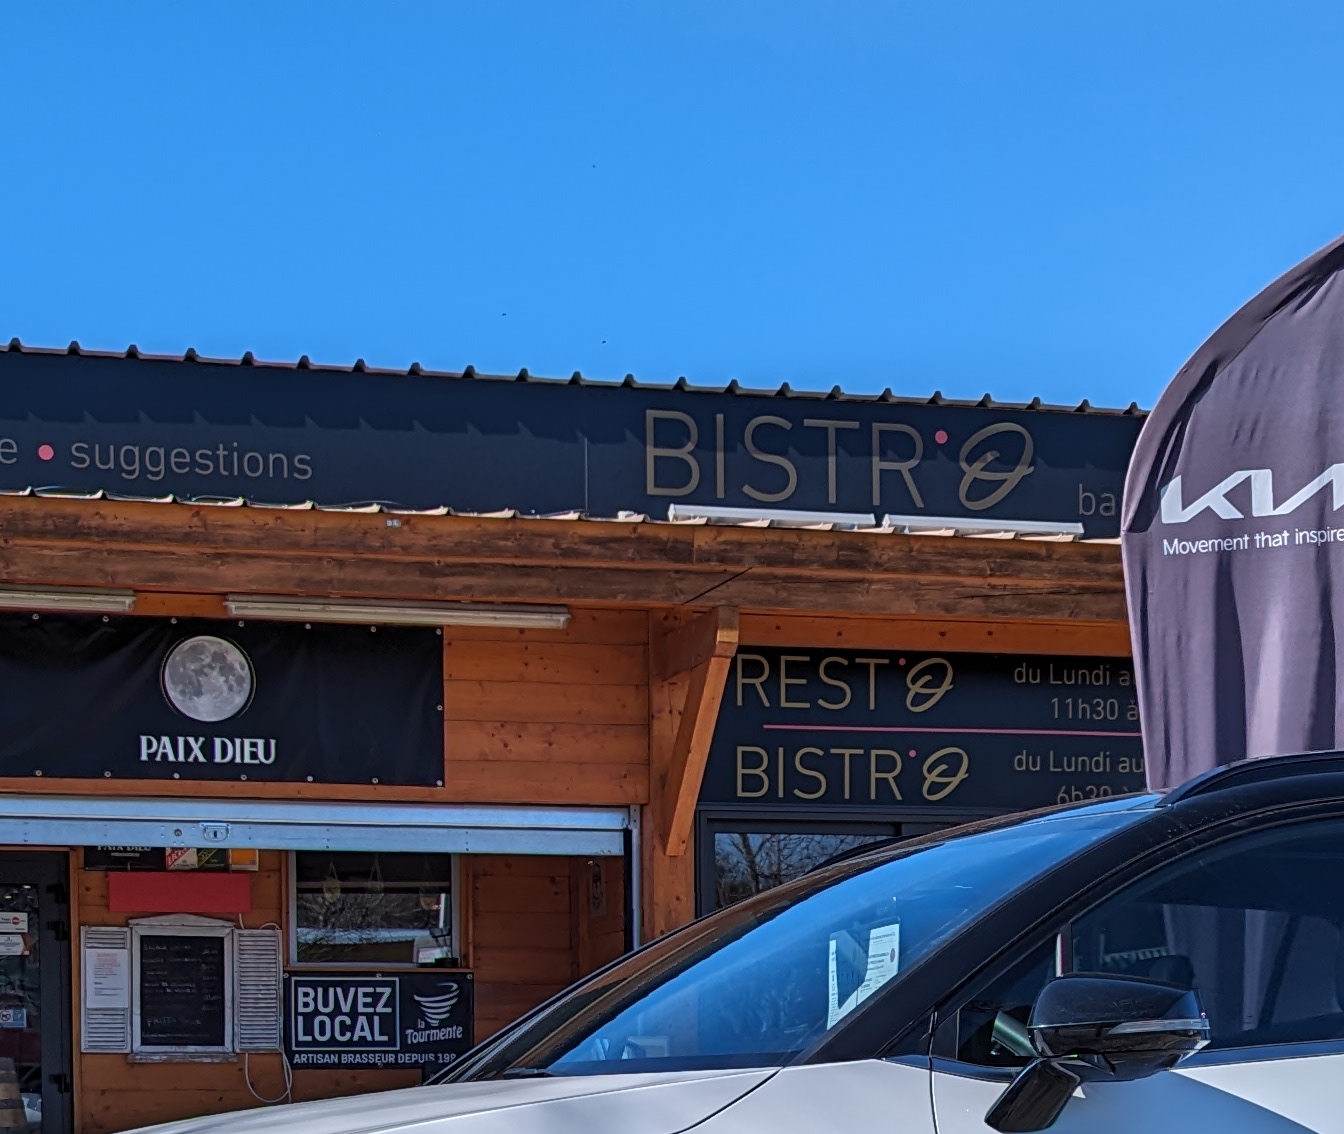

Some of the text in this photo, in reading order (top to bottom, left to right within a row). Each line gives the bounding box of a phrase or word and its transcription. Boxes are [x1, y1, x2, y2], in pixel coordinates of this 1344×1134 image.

[69, 436, 314, 480] suggestions
[1078, 484, 1116, 516] ba
[1163, 532, 1250, 556] Movement
[1254, 529, 1290, 549] that
[1014, 662, 1136, 687] du Lundi a
[1051, 697, 1138, 721] 11h30 à
[139, 735, 277, 765] PAIX DIEU
[1014, 750, 1144, 773] du Lundi au
[297, 986, 393, 1014] BUVEZ
[297, 1015, 389, 1042] LOCAL
[405, 1023, 464, 1045] Tourmente
[417, 1018, 425, 1029] la
[293, 1053, 339, 1064] ARTISAN
[341, 1053, 396, 1064] BRASSEUR
[397, 1053, 435, 1064] DEPUIS
